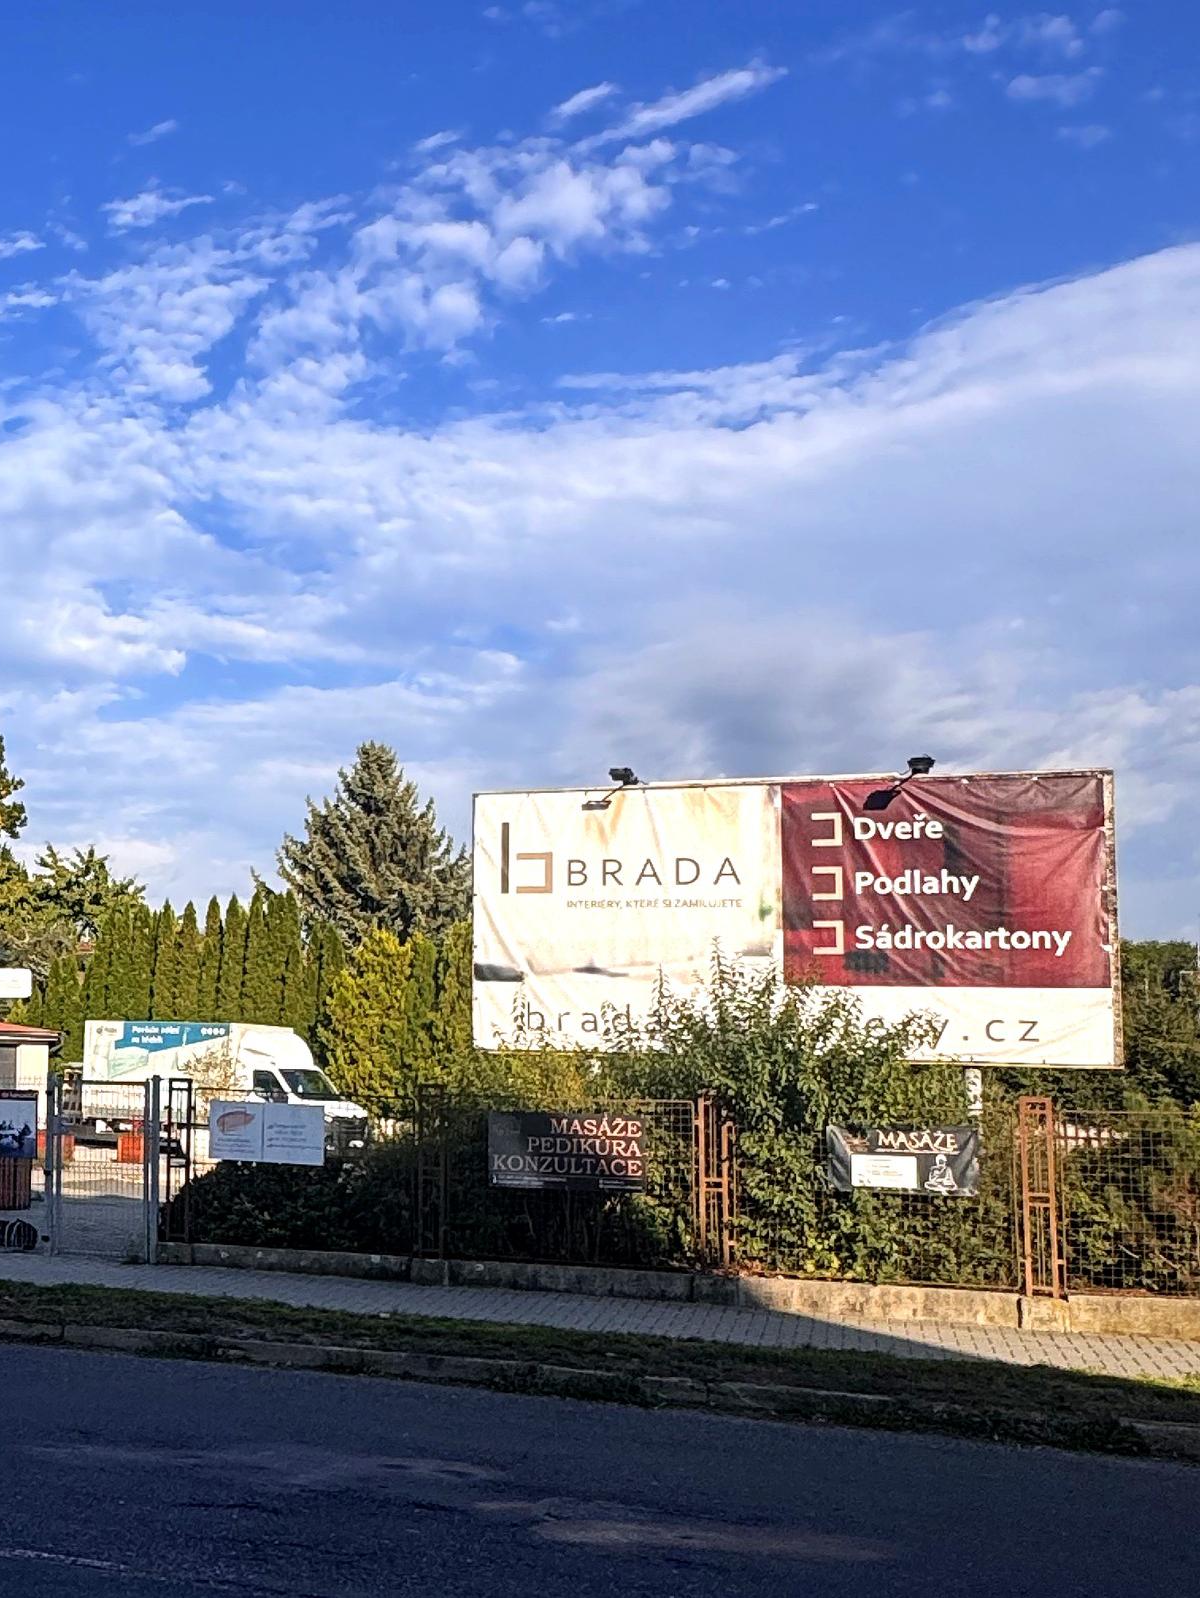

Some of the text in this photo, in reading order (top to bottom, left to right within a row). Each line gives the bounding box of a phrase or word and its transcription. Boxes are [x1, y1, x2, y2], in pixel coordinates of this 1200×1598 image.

[853, 813, 944, 840] Dveře
[566, 857, 742, 887] BRADA
[854, 869, 980, 901] Podlahy
[854, 924, 1073, 957] Sádrokartony
[550, 1112, 643, 1138] MASÁŽE
[527, 1136, 642, 1158] PEDIKÚRA
[876, 1130, 959, 1151] MASÁŽE
[492, 1153, 643, 1177] KONZULTACE
